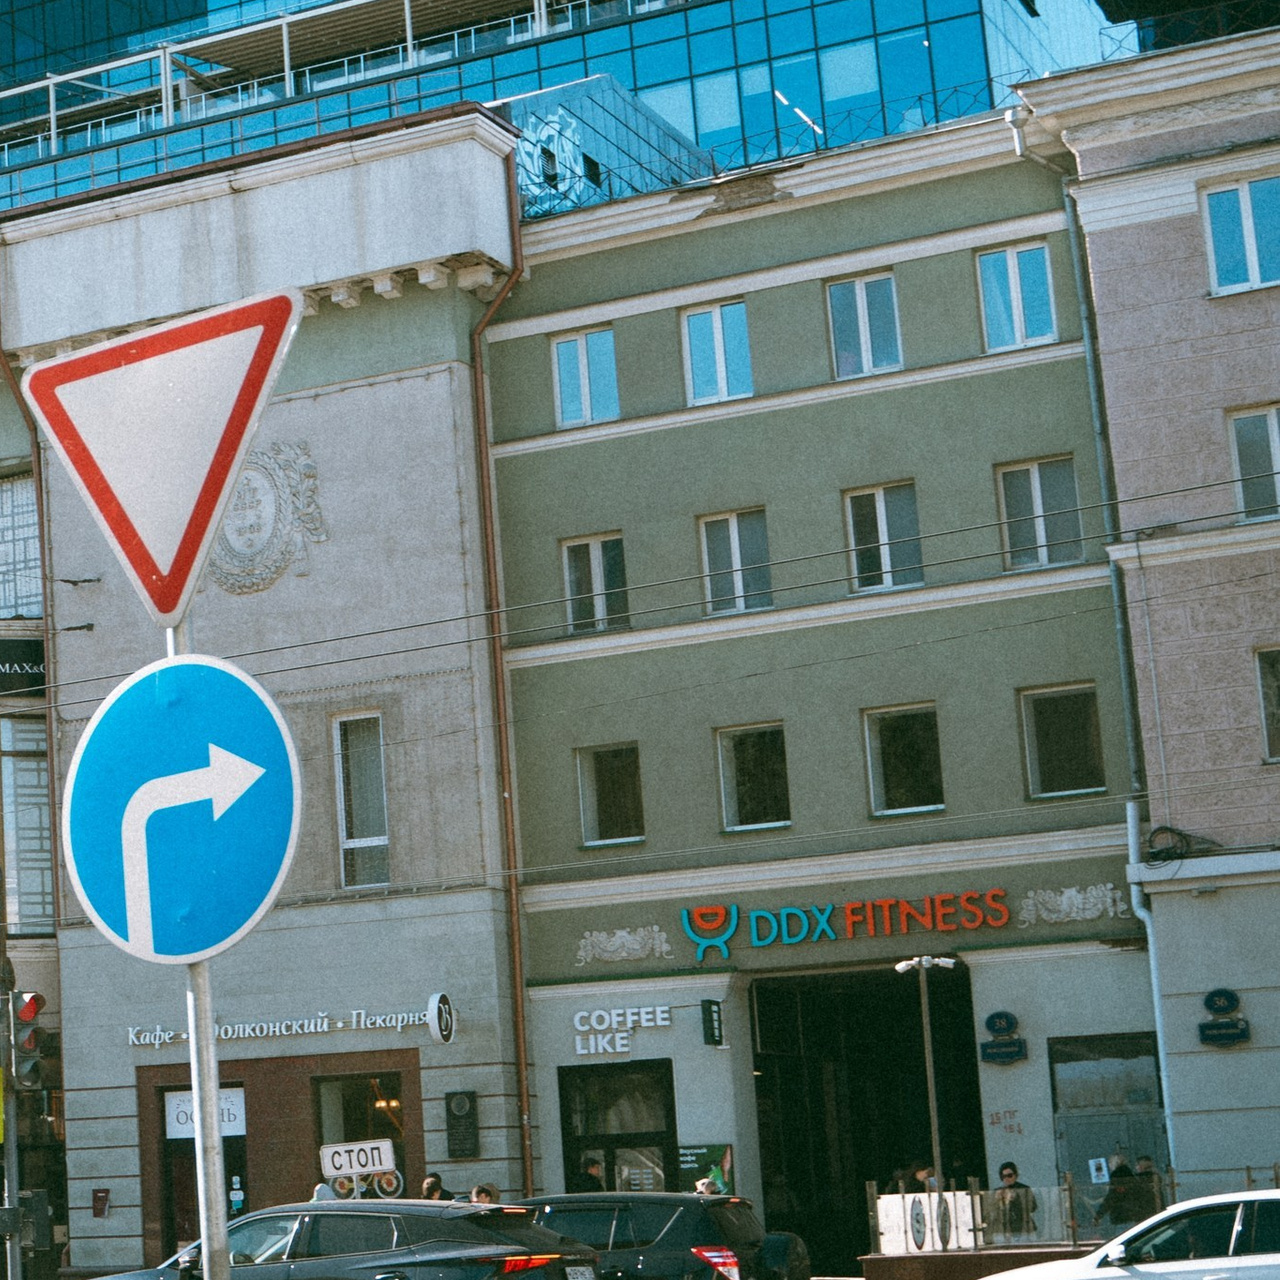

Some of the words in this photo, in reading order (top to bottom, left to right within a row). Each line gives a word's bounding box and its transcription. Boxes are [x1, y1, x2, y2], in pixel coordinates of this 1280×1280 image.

[749, 903, 838, 948] DDX
[844, 887, 1011, 940] FITNESS
[127, 1025, 174, 1048] Кафе
[350, 1009, 429, 1032] Пекарня
[573, 1006, 671, 1031] COFFEE
[575, 1031, 631, 1055] LIKE
[331, 1146, 383, 1171] СТОП
